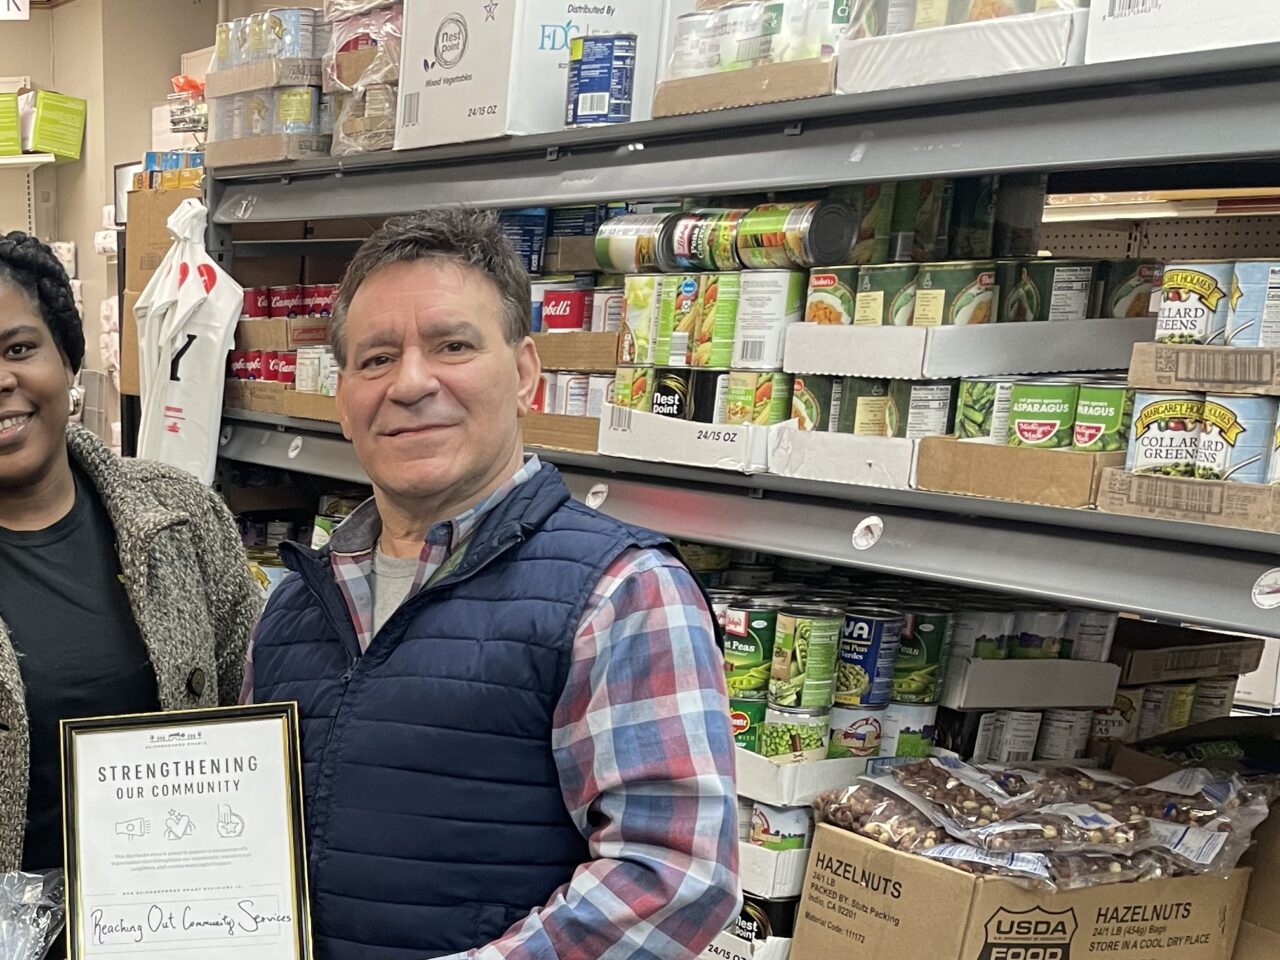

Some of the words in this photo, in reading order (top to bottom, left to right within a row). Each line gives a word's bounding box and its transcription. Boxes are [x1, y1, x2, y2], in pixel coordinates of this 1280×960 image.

[567, 4, 605, 15] Distributed
[606, 5, 616, 16] By
[441, 31, 461, 43] nest
[441, 41, 460, 53] point
[1181, 272, 1214, 291] HOLMES
[653, 391, 680, 406] nest
[652, 404, 678, 415] point
[1013, 403, 1070, 413] ASPARAGUS
[1143, 403, 1185, 420] MARGARET
[696, 429, 721, 442] 24/15
[722, 431, 738, 443] OZ
[1141, 436, 1198, 448] COLLAR
[732, 640, 756, 653] Peas
[98, 755, 258, 783] STRENGTHENING
[116, 786, 145, 800] OUR
[151, 779, 241, 798] COMMUNITY
[815, 851, 903, 899] HAZELNUTS
[810, 881, 838, 900] PACKED
[869, 906, 900, 927] Packing
[826, 900, 837, 911] CA
[1095, 901, 1193, 925] HAZELNUTS
[90, 908, 144, 945] Reaching
[147, 904, 177, 933] Out
[237, 900, 293, 933] Services
[735, 915, 758, 933] nest
[996, 919, 1067, 936] USDA
[1091, 927, 1109, 937] 24/1
[1110, 926, 1123, 936] LB
[1123, 925, 1148, 937] (454g)
[1148, 924, 1168, 937] Bags
[735, 925, 757, 940] point
[1088, 940, 1120, 953] STORE
[1120, 940, 1131, 951] IN
[1130, 940, 1139, 950] A
[1166, 936, 1183, 948] DRY
[1183, 933, 1211, 945] PLACE
[707, 943, 732, 960] 24/15
